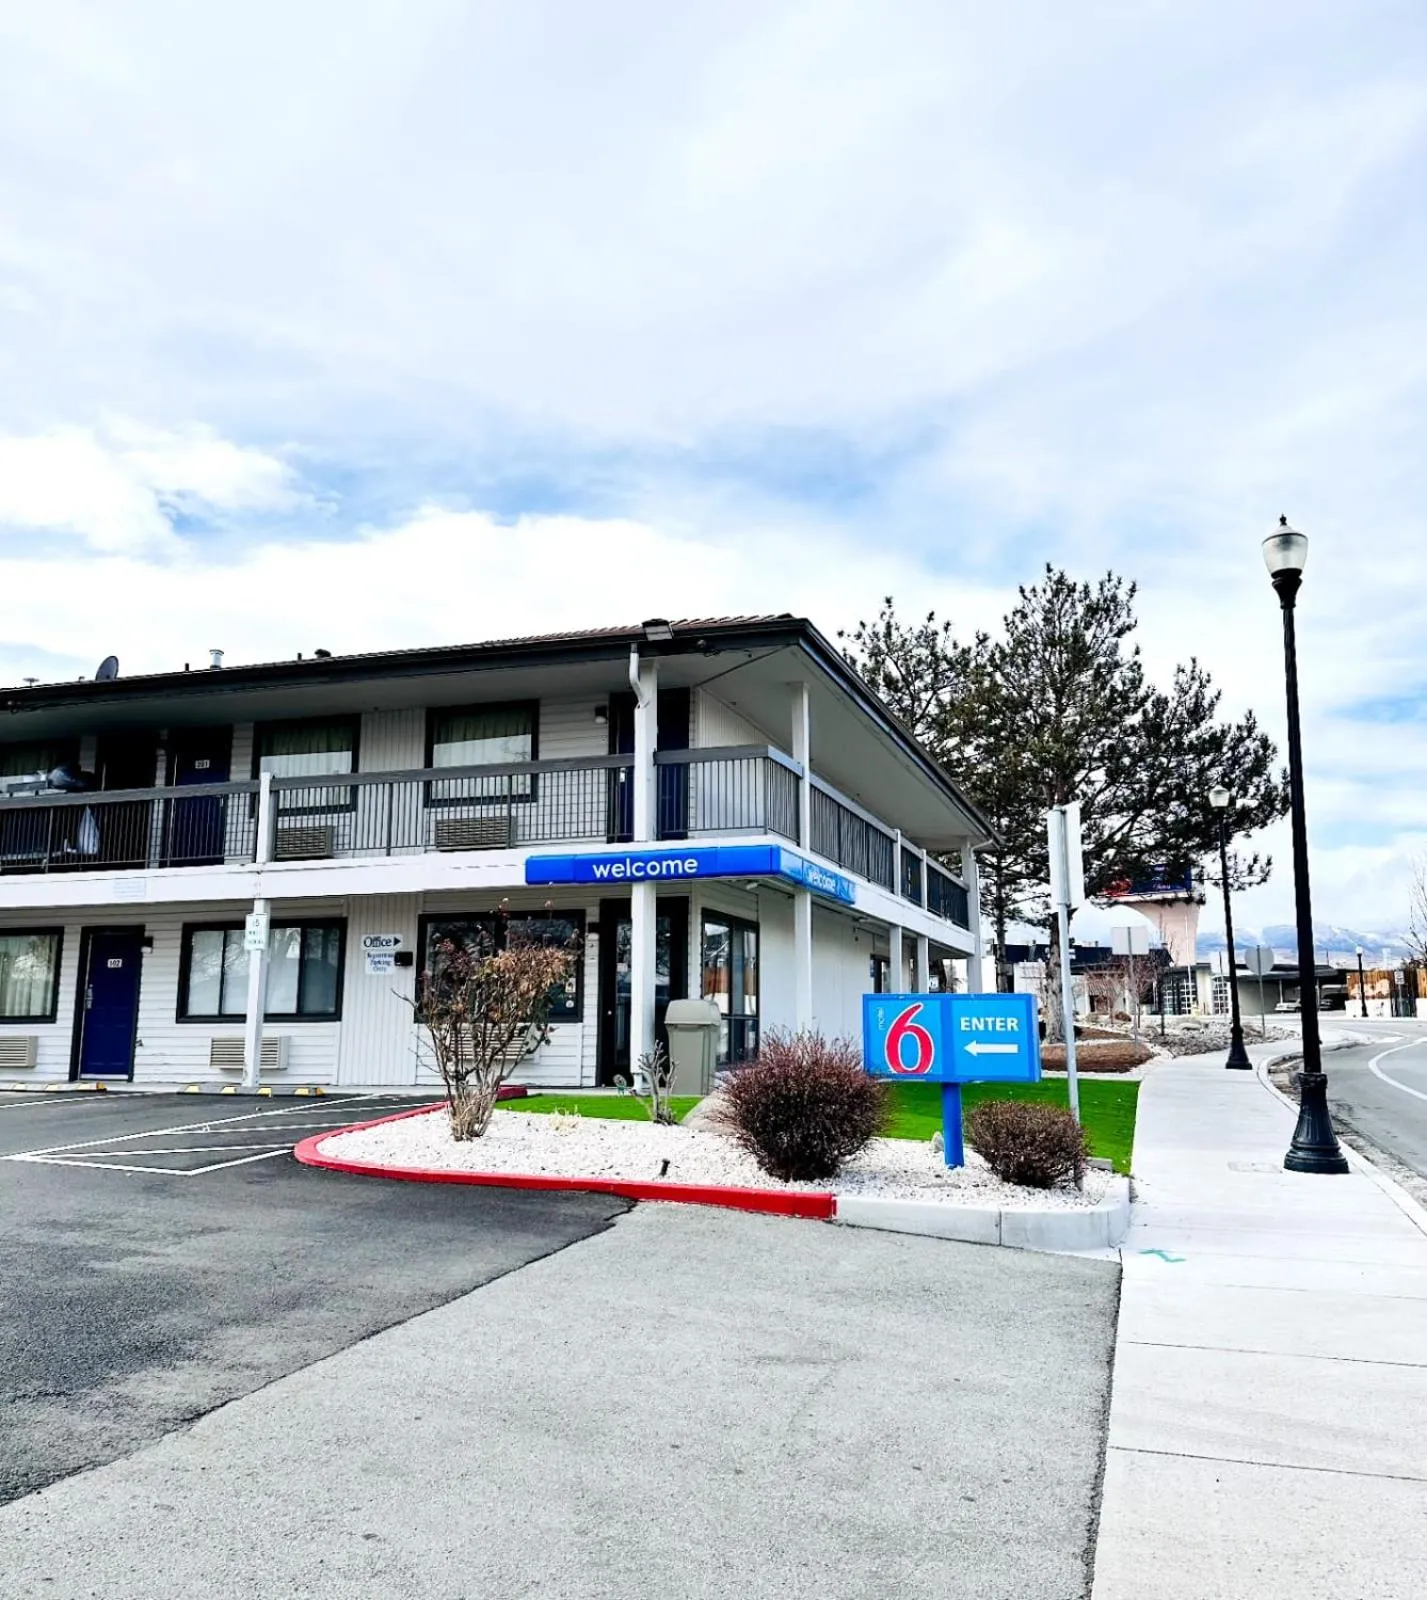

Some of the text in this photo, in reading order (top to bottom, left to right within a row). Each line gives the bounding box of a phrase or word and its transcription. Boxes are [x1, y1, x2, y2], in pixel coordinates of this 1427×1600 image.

[592, 858, 698, 878] welcome
[363, 936, 392, 948] Office
[960, 1017, 1020, 1032] ENTER
[884, 1002, 935, 1075] 6
